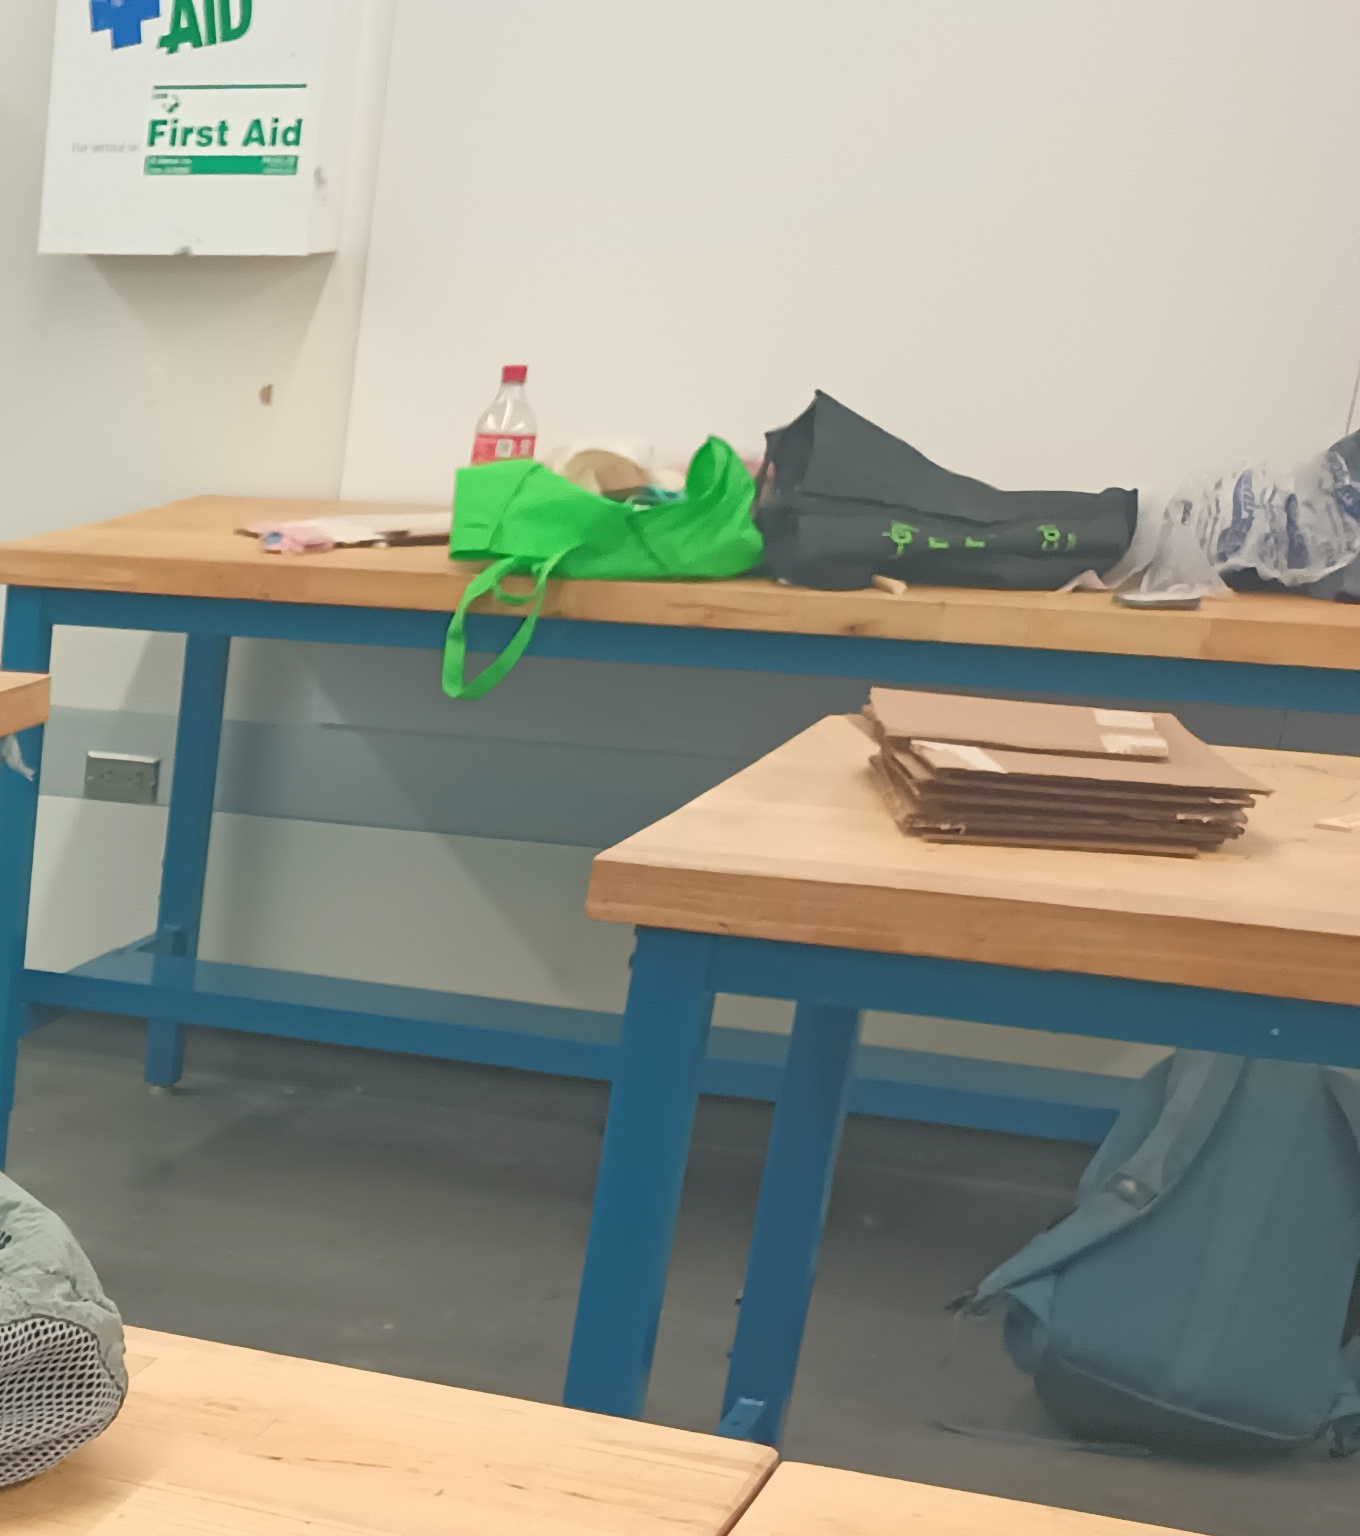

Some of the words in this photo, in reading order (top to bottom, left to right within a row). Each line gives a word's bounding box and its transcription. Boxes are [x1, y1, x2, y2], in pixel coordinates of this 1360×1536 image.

[156, 0, 253, 55] AID
[147, 118, 229, 147] First
[241, 117, 303, 147] Aid
